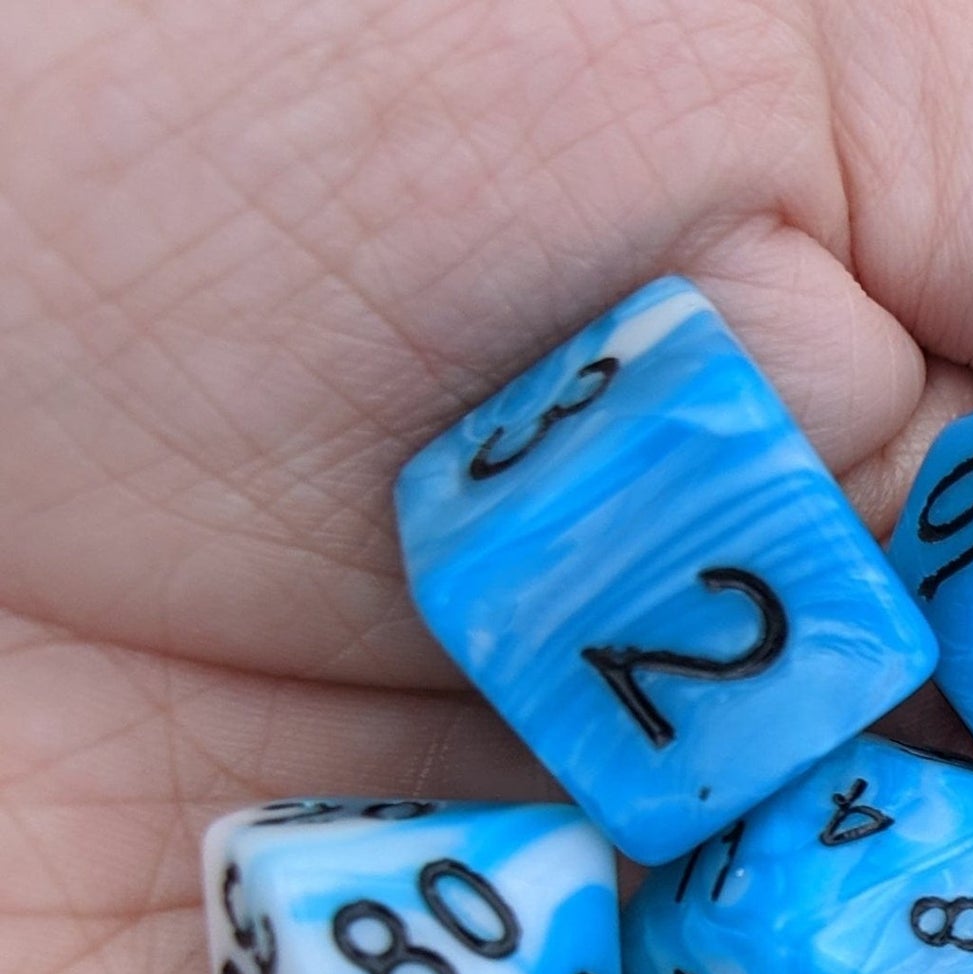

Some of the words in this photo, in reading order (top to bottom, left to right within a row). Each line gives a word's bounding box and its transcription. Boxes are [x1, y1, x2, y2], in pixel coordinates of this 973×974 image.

[470, 357, 620, 481] 3
[580, 566, 789, 751] 2
[819, 778, 894, 847] 4
